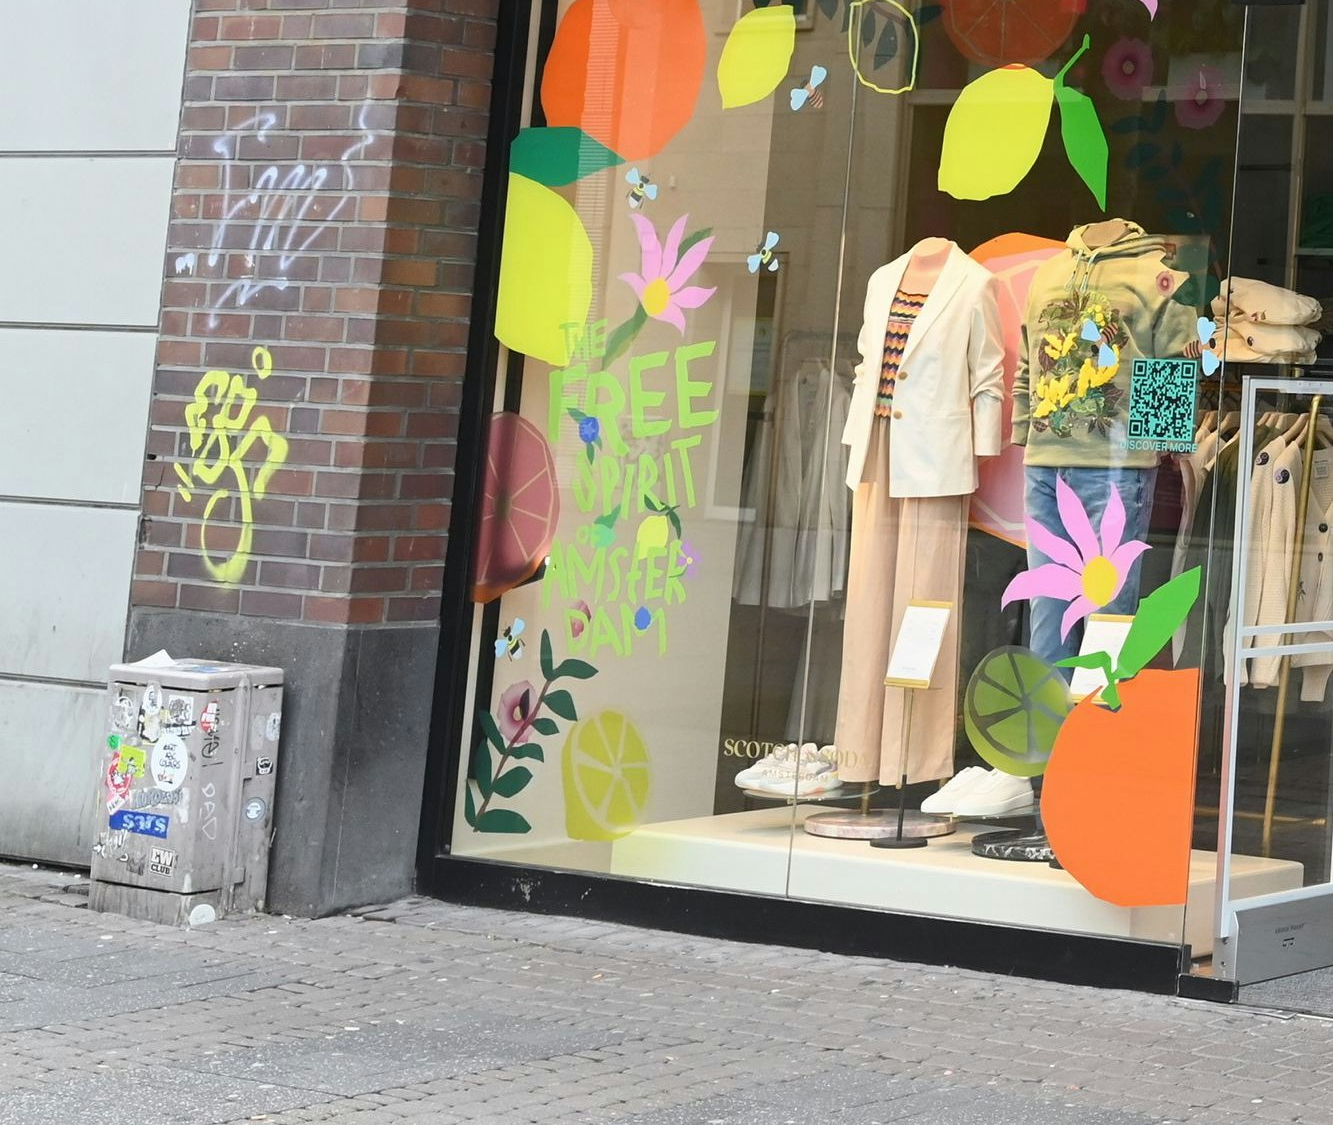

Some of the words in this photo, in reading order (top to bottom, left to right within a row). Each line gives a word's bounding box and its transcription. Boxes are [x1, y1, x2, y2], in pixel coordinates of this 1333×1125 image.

[547, 340, 720, 457] FREE
[1170, 442, 1198, 453] MORE
[573, 435, 702, 520] SPIRIT
[565, 606, 667, 658] DAM
[150, 863, 171, 874] CLUB
